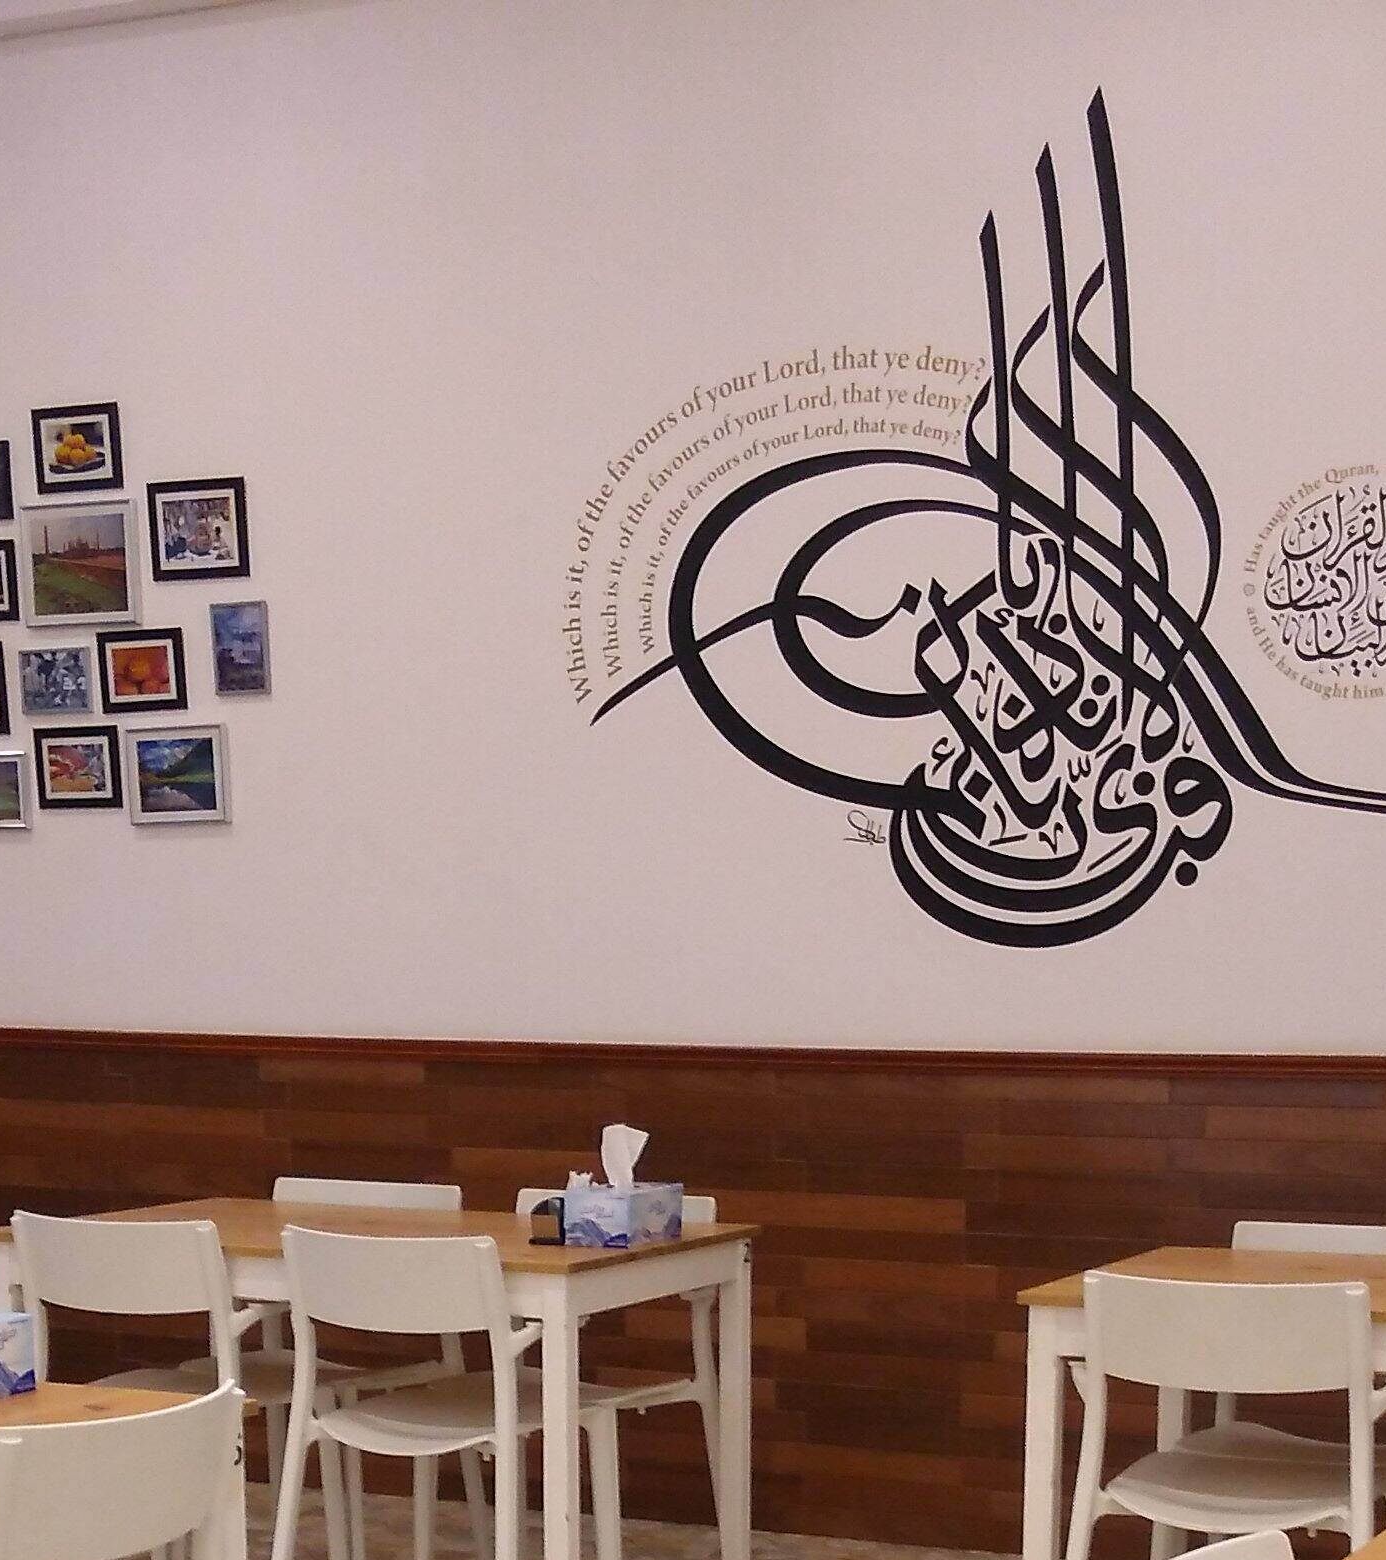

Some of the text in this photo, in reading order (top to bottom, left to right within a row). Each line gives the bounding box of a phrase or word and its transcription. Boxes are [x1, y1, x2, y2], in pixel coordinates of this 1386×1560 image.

[562, 345, 987, 705] Which is it, of the favours of your Lord, that ye deny?
[600, 382, 973, 678] Which is it, of the favours of your Lord, that ye deny?
[638, 416, 962, 655] Which is it, of the favours of your Lord, that ye deny?
[1297, 479, 1322, 499] the
[1246, 607, 1266, 636] and
[1258, 636, 1277, 661] He
[1275, 655, 1299, 680] has
[1299, 675, 1349, 701] taught
[1353, 684, 1384, 699] him
